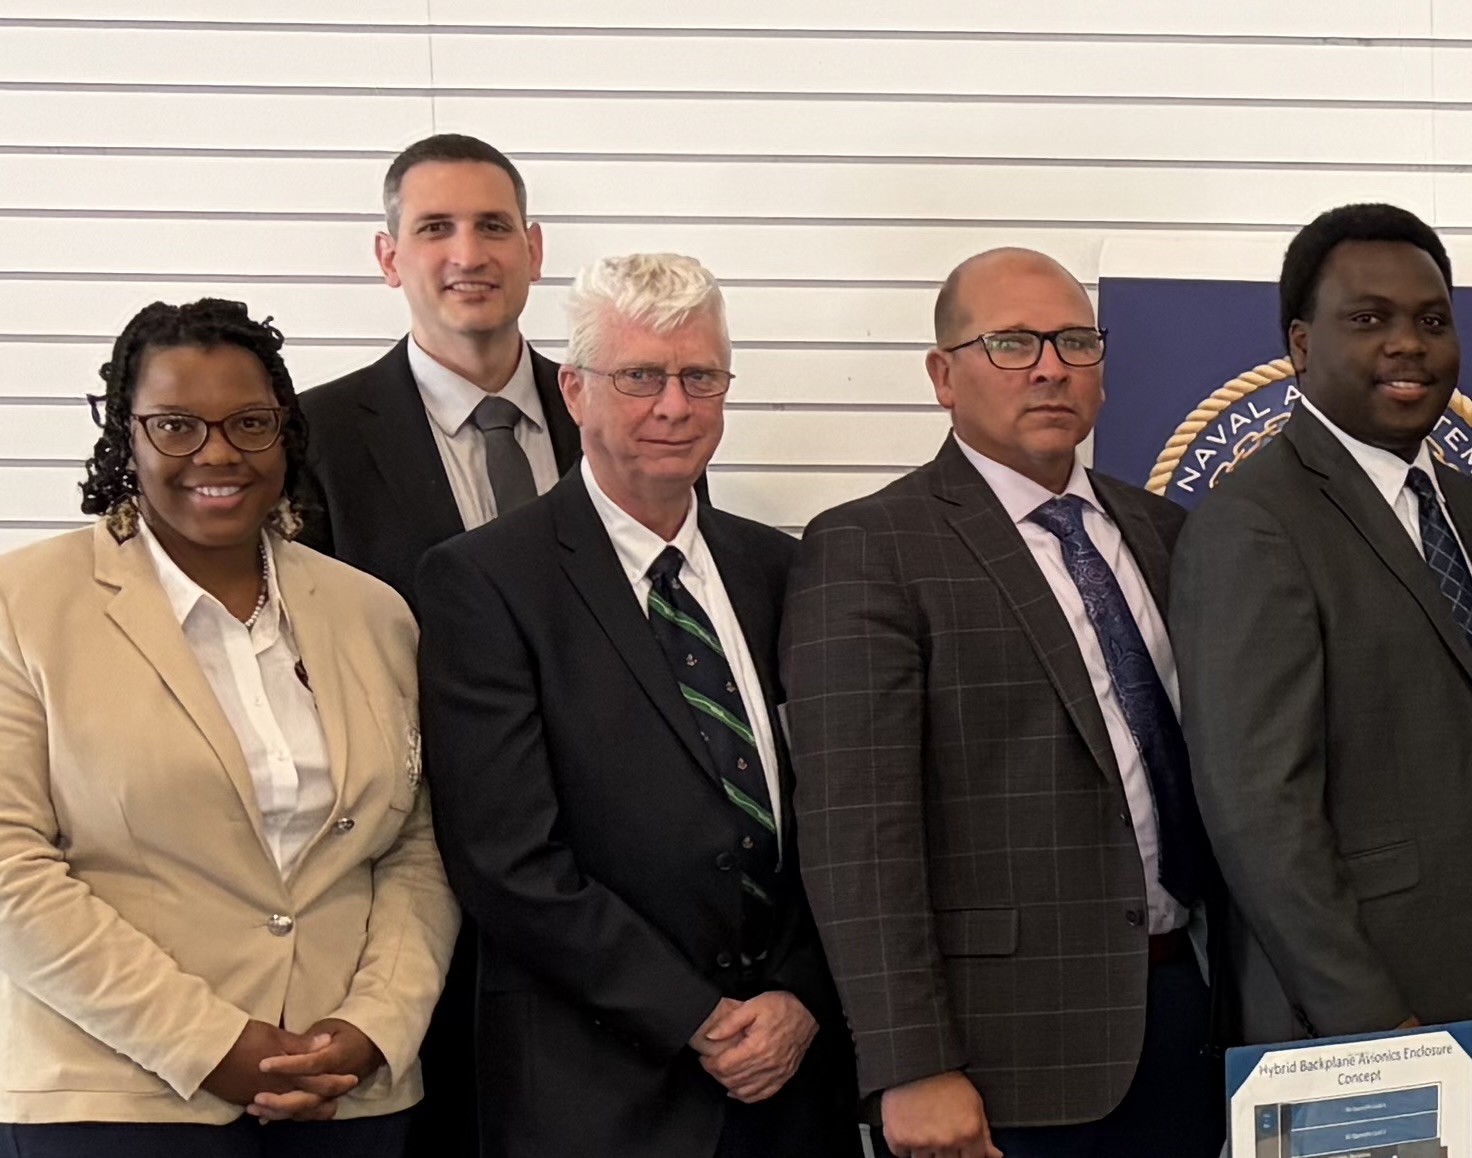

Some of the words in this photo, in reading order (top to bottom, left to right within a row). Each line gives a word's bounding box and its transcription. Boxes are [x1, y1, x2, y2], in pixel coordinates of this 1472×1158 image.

[1177, 402, 1272, 492] NAVAL
[1259, 1060, 1297, 1079] Hybrid
[1300, 1056, 1356, 1073] Backplane
[1358, 1051, 1401, 1066] Avionics
[1404, 1044, 1453, 1059] Enclosure
[1337, 1070, 1382, 1086] Concept
